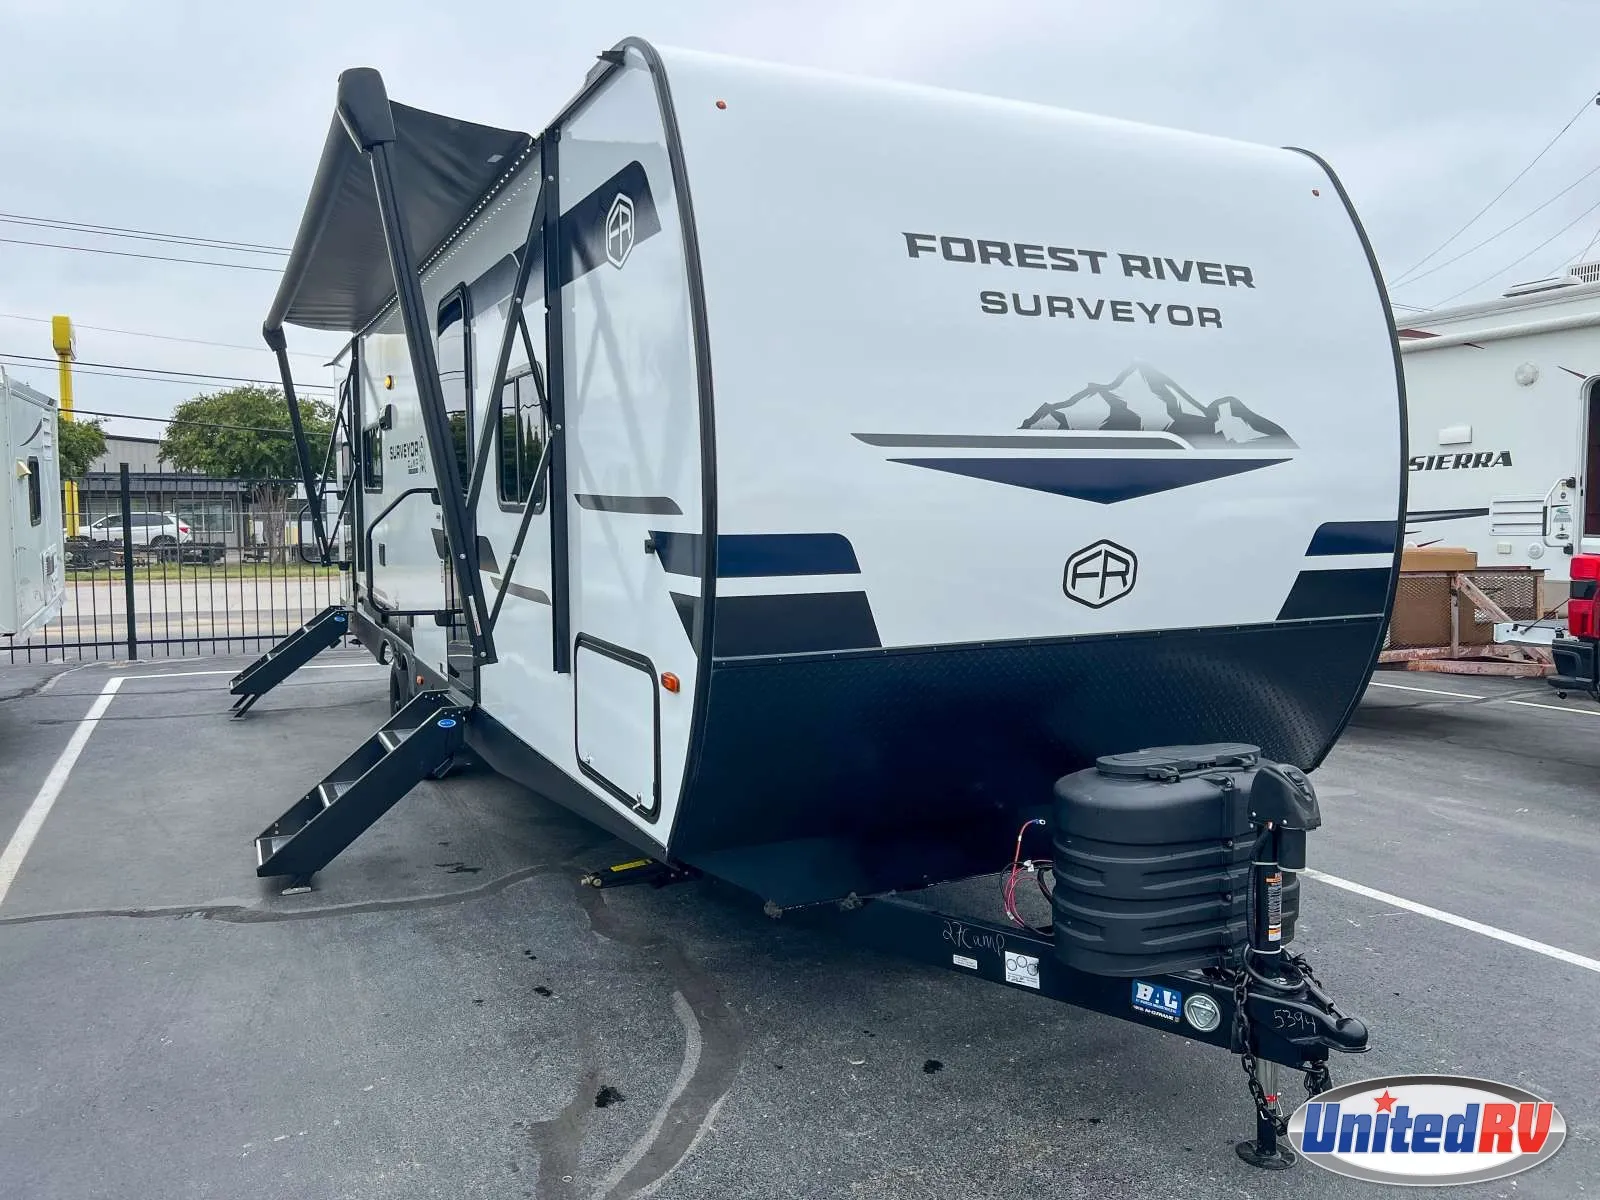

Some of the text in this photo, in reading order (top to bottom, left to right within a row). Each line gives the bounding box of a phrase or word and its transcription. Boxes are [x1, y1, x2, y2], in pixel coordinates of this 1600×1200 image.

[901, 232, 1257, 288] FOREST RIVER
[980, 291, 1223, 329] SURVEYOR
[389, 441, 419, 460] SURVEYOR
[1408, 450, 1513, 472] SIERRA
[1272, 1009, 1317, 1034] 5394
